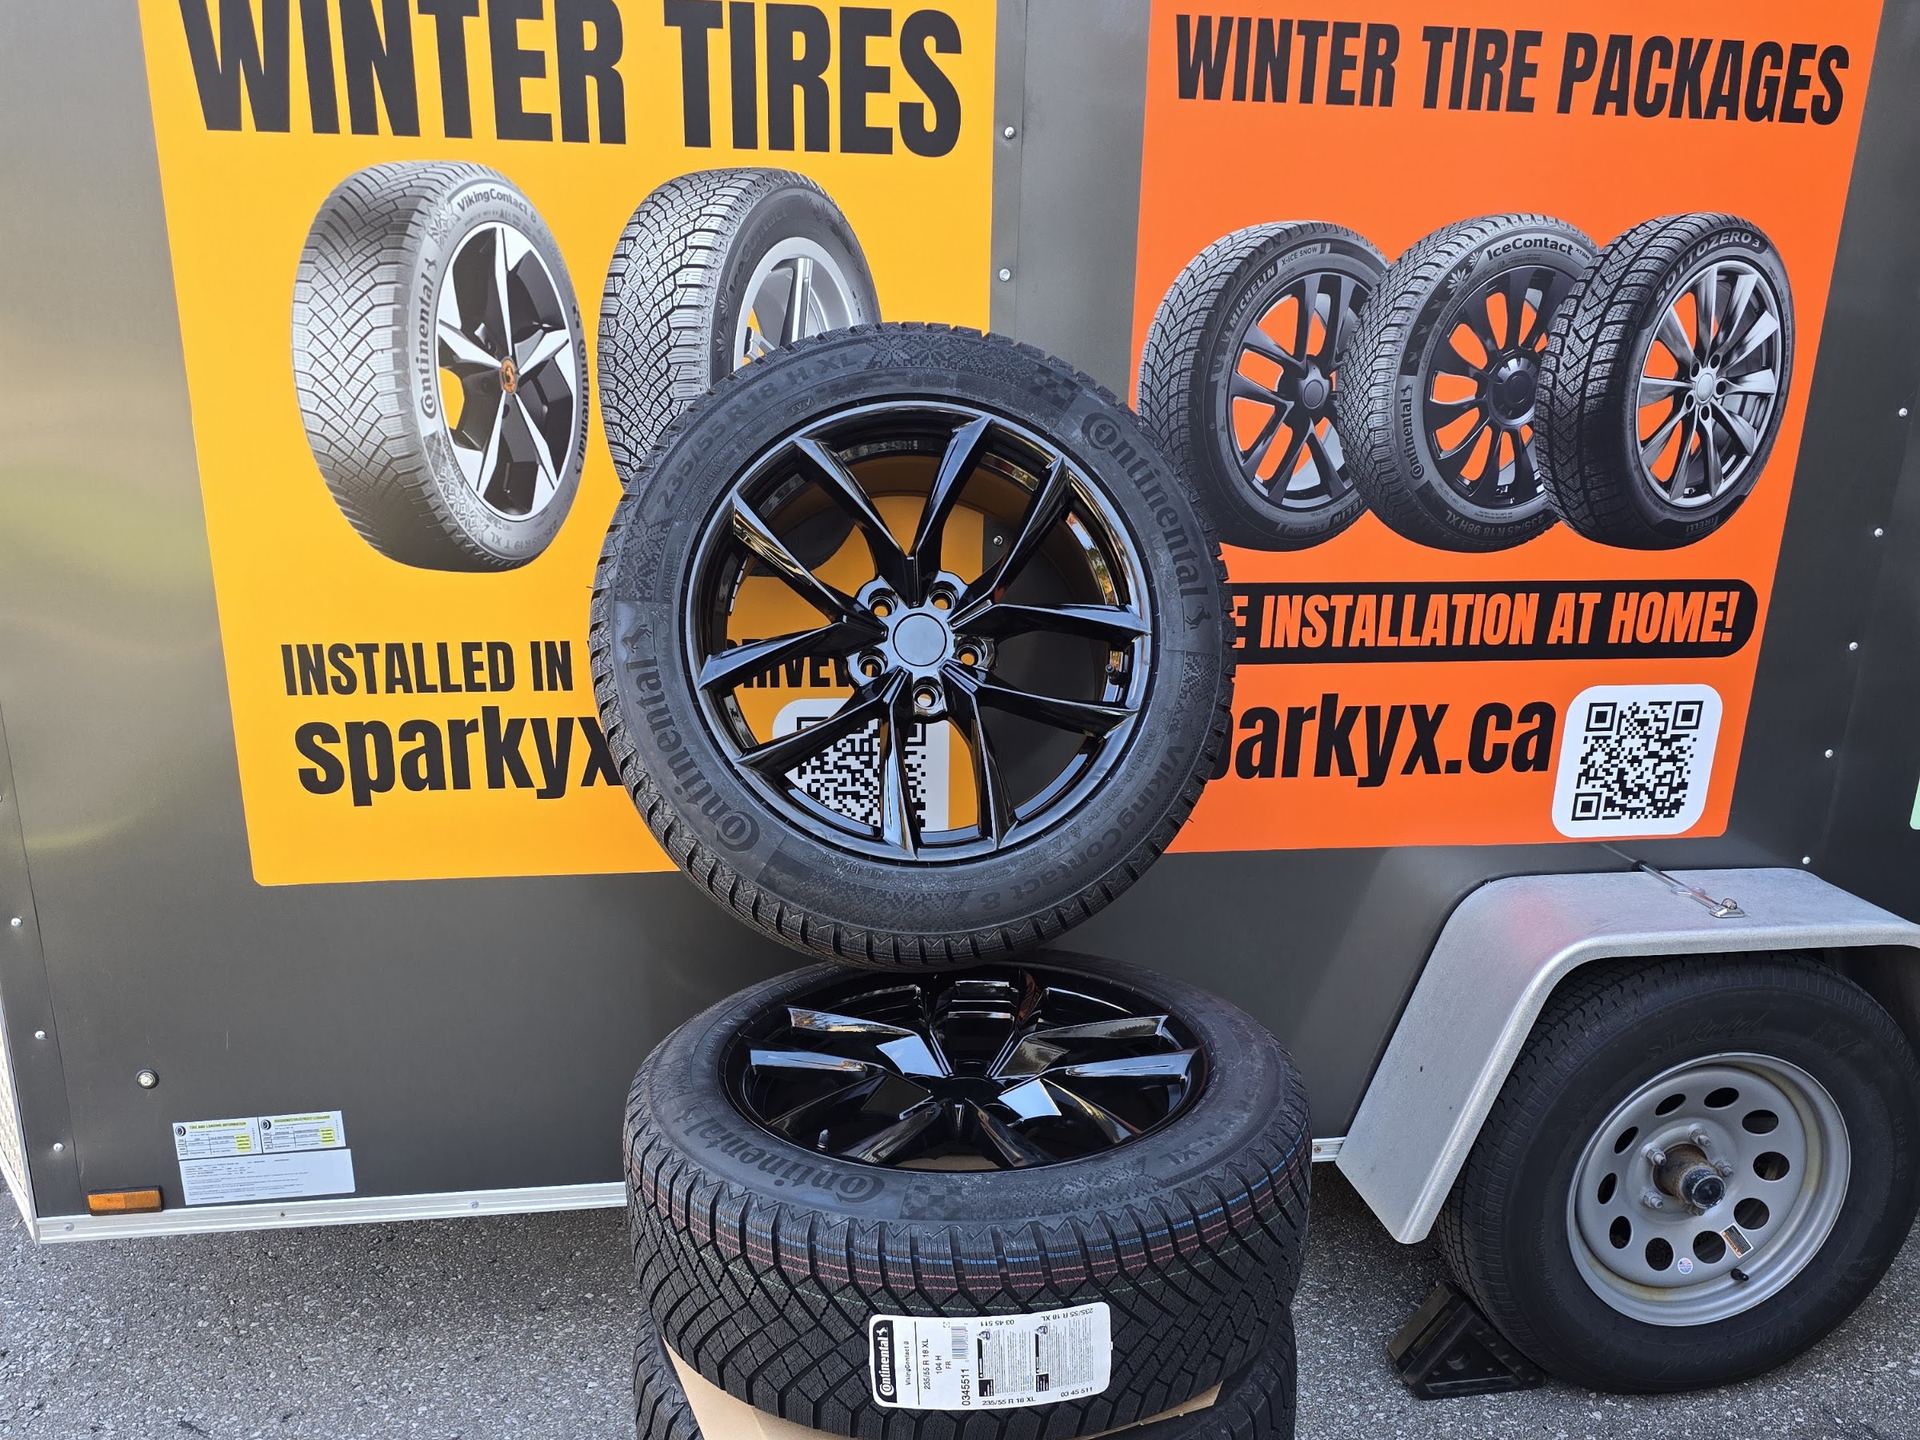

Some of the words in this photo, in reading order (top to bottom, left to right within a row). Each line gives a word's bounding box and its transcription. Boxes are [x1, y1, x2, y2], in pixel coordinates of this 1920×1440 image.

[181, 0, 627, 145] WINTER
[664, 5, 963, 157] TIRES
[1175, 14, 1401, 108] WINTER
[1420, 25, 1543, 115] TIRE
[1556, 33, 1850, 126] PACKAGES
[457, 188, 528, 214] VikingContact
[1229, 264, 1276, 327] MICHELIN
[1299, 246, 1318, 258] SNOW
[1487, 237, 1574, 262] IceContact
[1656, 231, 1752, 308] SOTTOZERO
[1752, 238, 1760, 248] 3
[416, 272, 436, 419] Continental
[1401, 398, 1425, 480] Continental
[1081, 412, 1208, 598] Continental
[1260, 591, 1543, 649] INSTALLATION
[1547, 591, 1601, 645] AT
[1607, 590, 1741, 645] HOME!
[281, 641, 516, 696] INSTALLED
[530, 640, 573, 691] IN
[626, 656, 760, 853] Continental
[684, 1116, 886, 1204] Continental
[879, 1336, 896, 1396] Continental
[961, 1368, 970, 1406] 0345511
